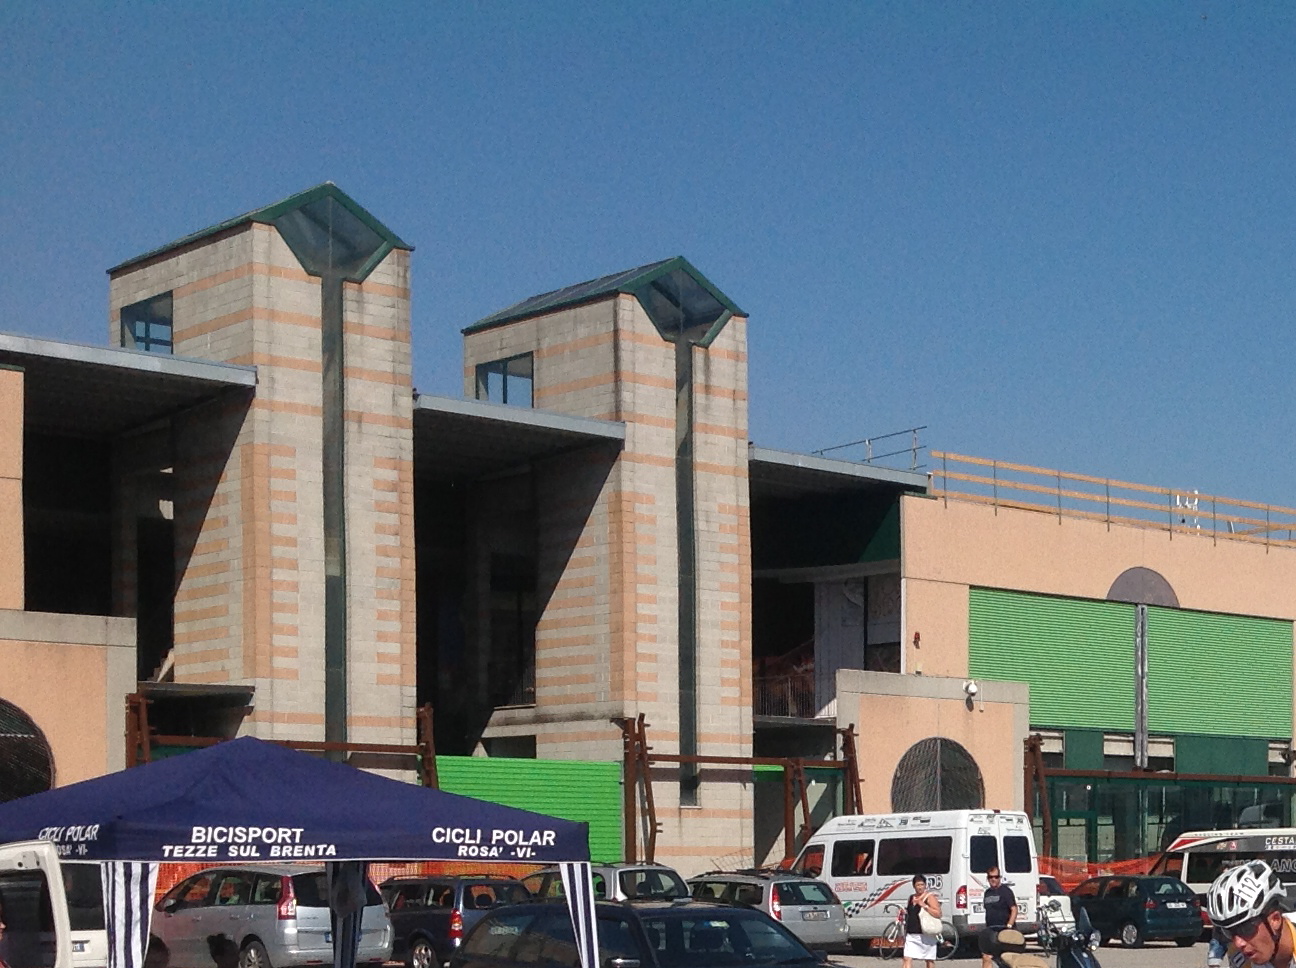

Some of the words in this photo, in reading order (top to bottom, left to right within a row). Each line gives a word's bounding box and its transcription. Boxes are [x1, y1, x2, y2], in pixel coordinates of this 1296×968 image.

[65, 824, 99, 842] POLAR
[191, 827, 304, 843] BICISPORT
[432, 827, 481, 844] CICLI
[492, 830, 556, 846] POLAR
[162, 845, 218, 857] TEZZE
[228, 845, 260, 857] SUL
[270, 844, 337, 857] BRENTA
[458, 845, 503, 857] ROSA'
[511, 847, 536, 858] -VI-
